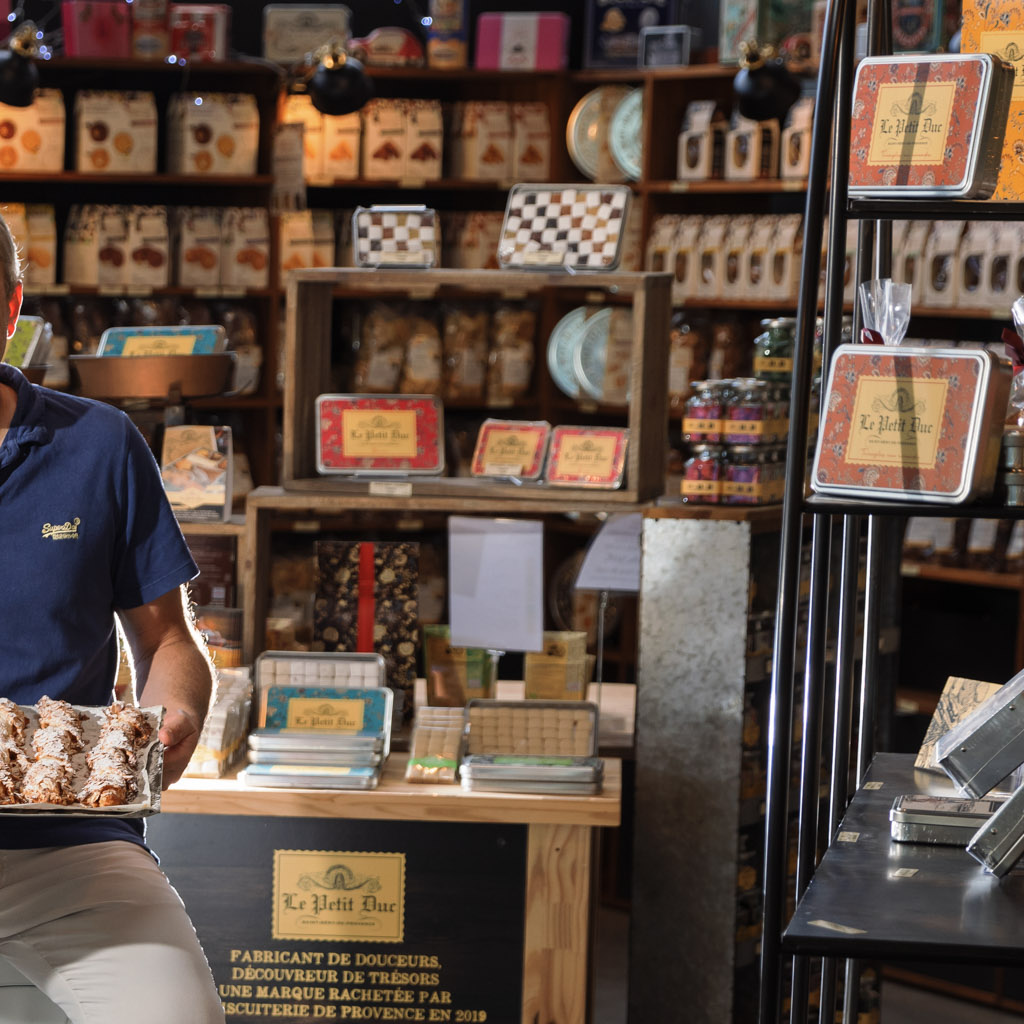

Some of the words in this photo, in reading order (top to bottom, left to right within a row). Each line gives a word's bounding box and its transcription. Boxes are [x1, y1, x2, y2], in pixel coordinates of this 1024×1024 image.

[880, 118, 893, 134] Le
[896, 118, 919, 137] Petit
[922, 118, 943, 134] Duc
[860, 414, 875, 432] Le
[878, 415, 906, 435] Petit
[909, 416, 934, 434] Duc
[282, 892, 307, 914] Le
[311, 893, 353, 915] Petit
[361, 895, 397, 914] Duc
[230, 949, 324, 965] FABRICANT
[327, 952, 352, 966] DE
[355, 953, 443, 970] DOUCEURS,
[232, 964, 339, 983] DÉCOUVREUR
[342, 970, 365, 984] DE
[368, 969, 440, 986] TRÉSORS
[219, 984, 253, 998] UNE
[255, 985, 325, 1001] MARQUE
[329, 987, 415, 1005] RACHETÉE
[418, 991, 452, 1005] PAR
[221, 1001, 310, 1017] ISCUITERIE
[313, 1004, 337, 1018] DE
[340, 1005, 426, 1020] PROVENCE
[429, 1008, 452, 1021] EN
[455, 1009, 488, 1023] 2019
